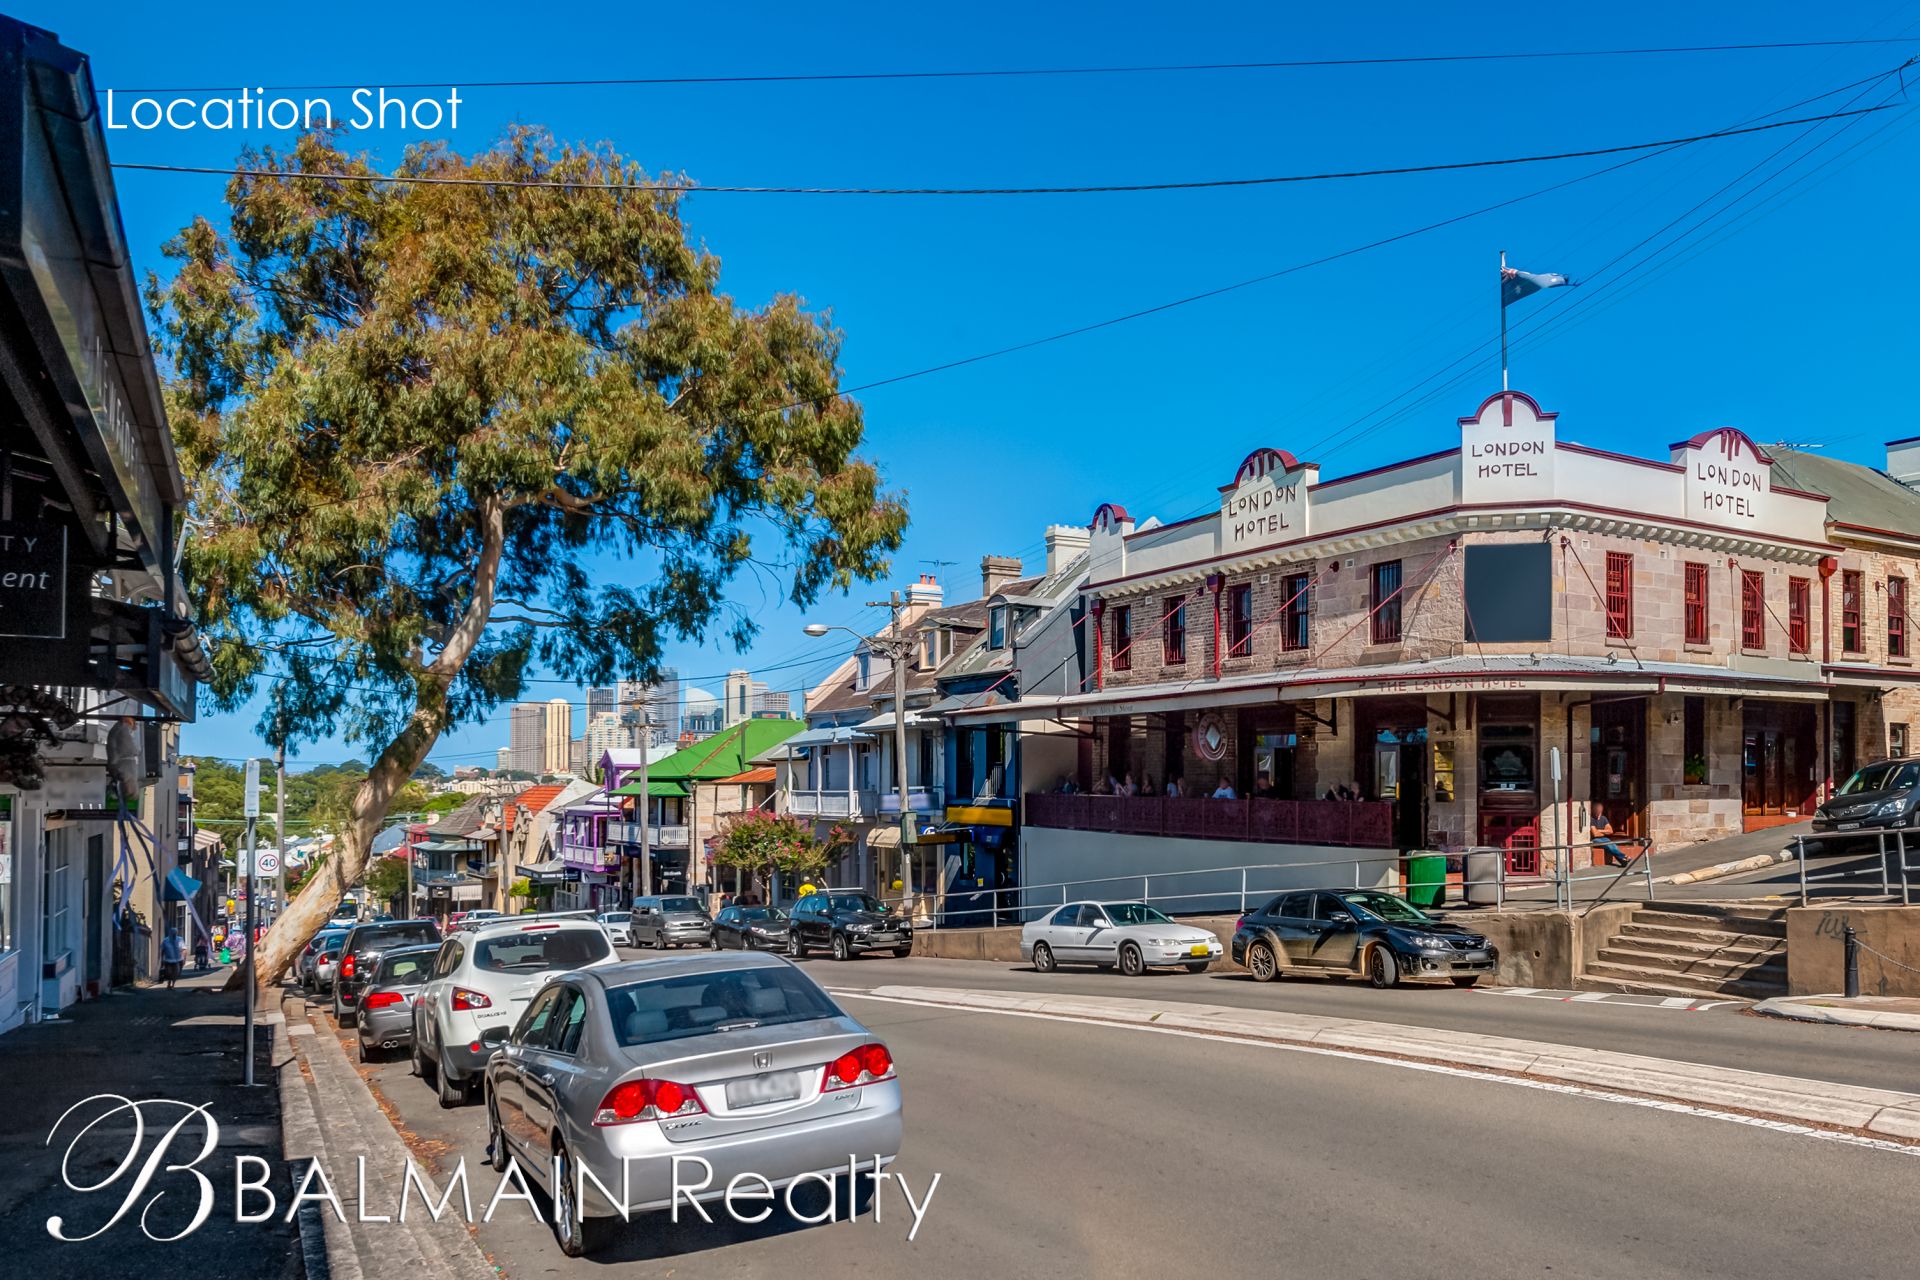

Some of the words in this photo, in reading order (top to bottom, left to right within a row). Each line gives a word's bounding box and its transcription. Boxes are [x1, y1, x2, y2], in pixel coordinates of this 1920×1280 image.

[1472, 441, 1544, 457] LONDON
[1479, 463, 1538, 478] HOTEL
[1698, 462, 1761, 492] LONDON
[1229, 483, 1297, 518] LONDON
[1703, 491, 1755, 518] HOTEL
[1234, 512, 1290, 542] HOTEL
[1377, 681, 1407, 692] THE
[1415, 678, 1474, 691] LONDON
[1481, 677, 1526, 689] HOTEL
[261, 858, 276, 868] 40
